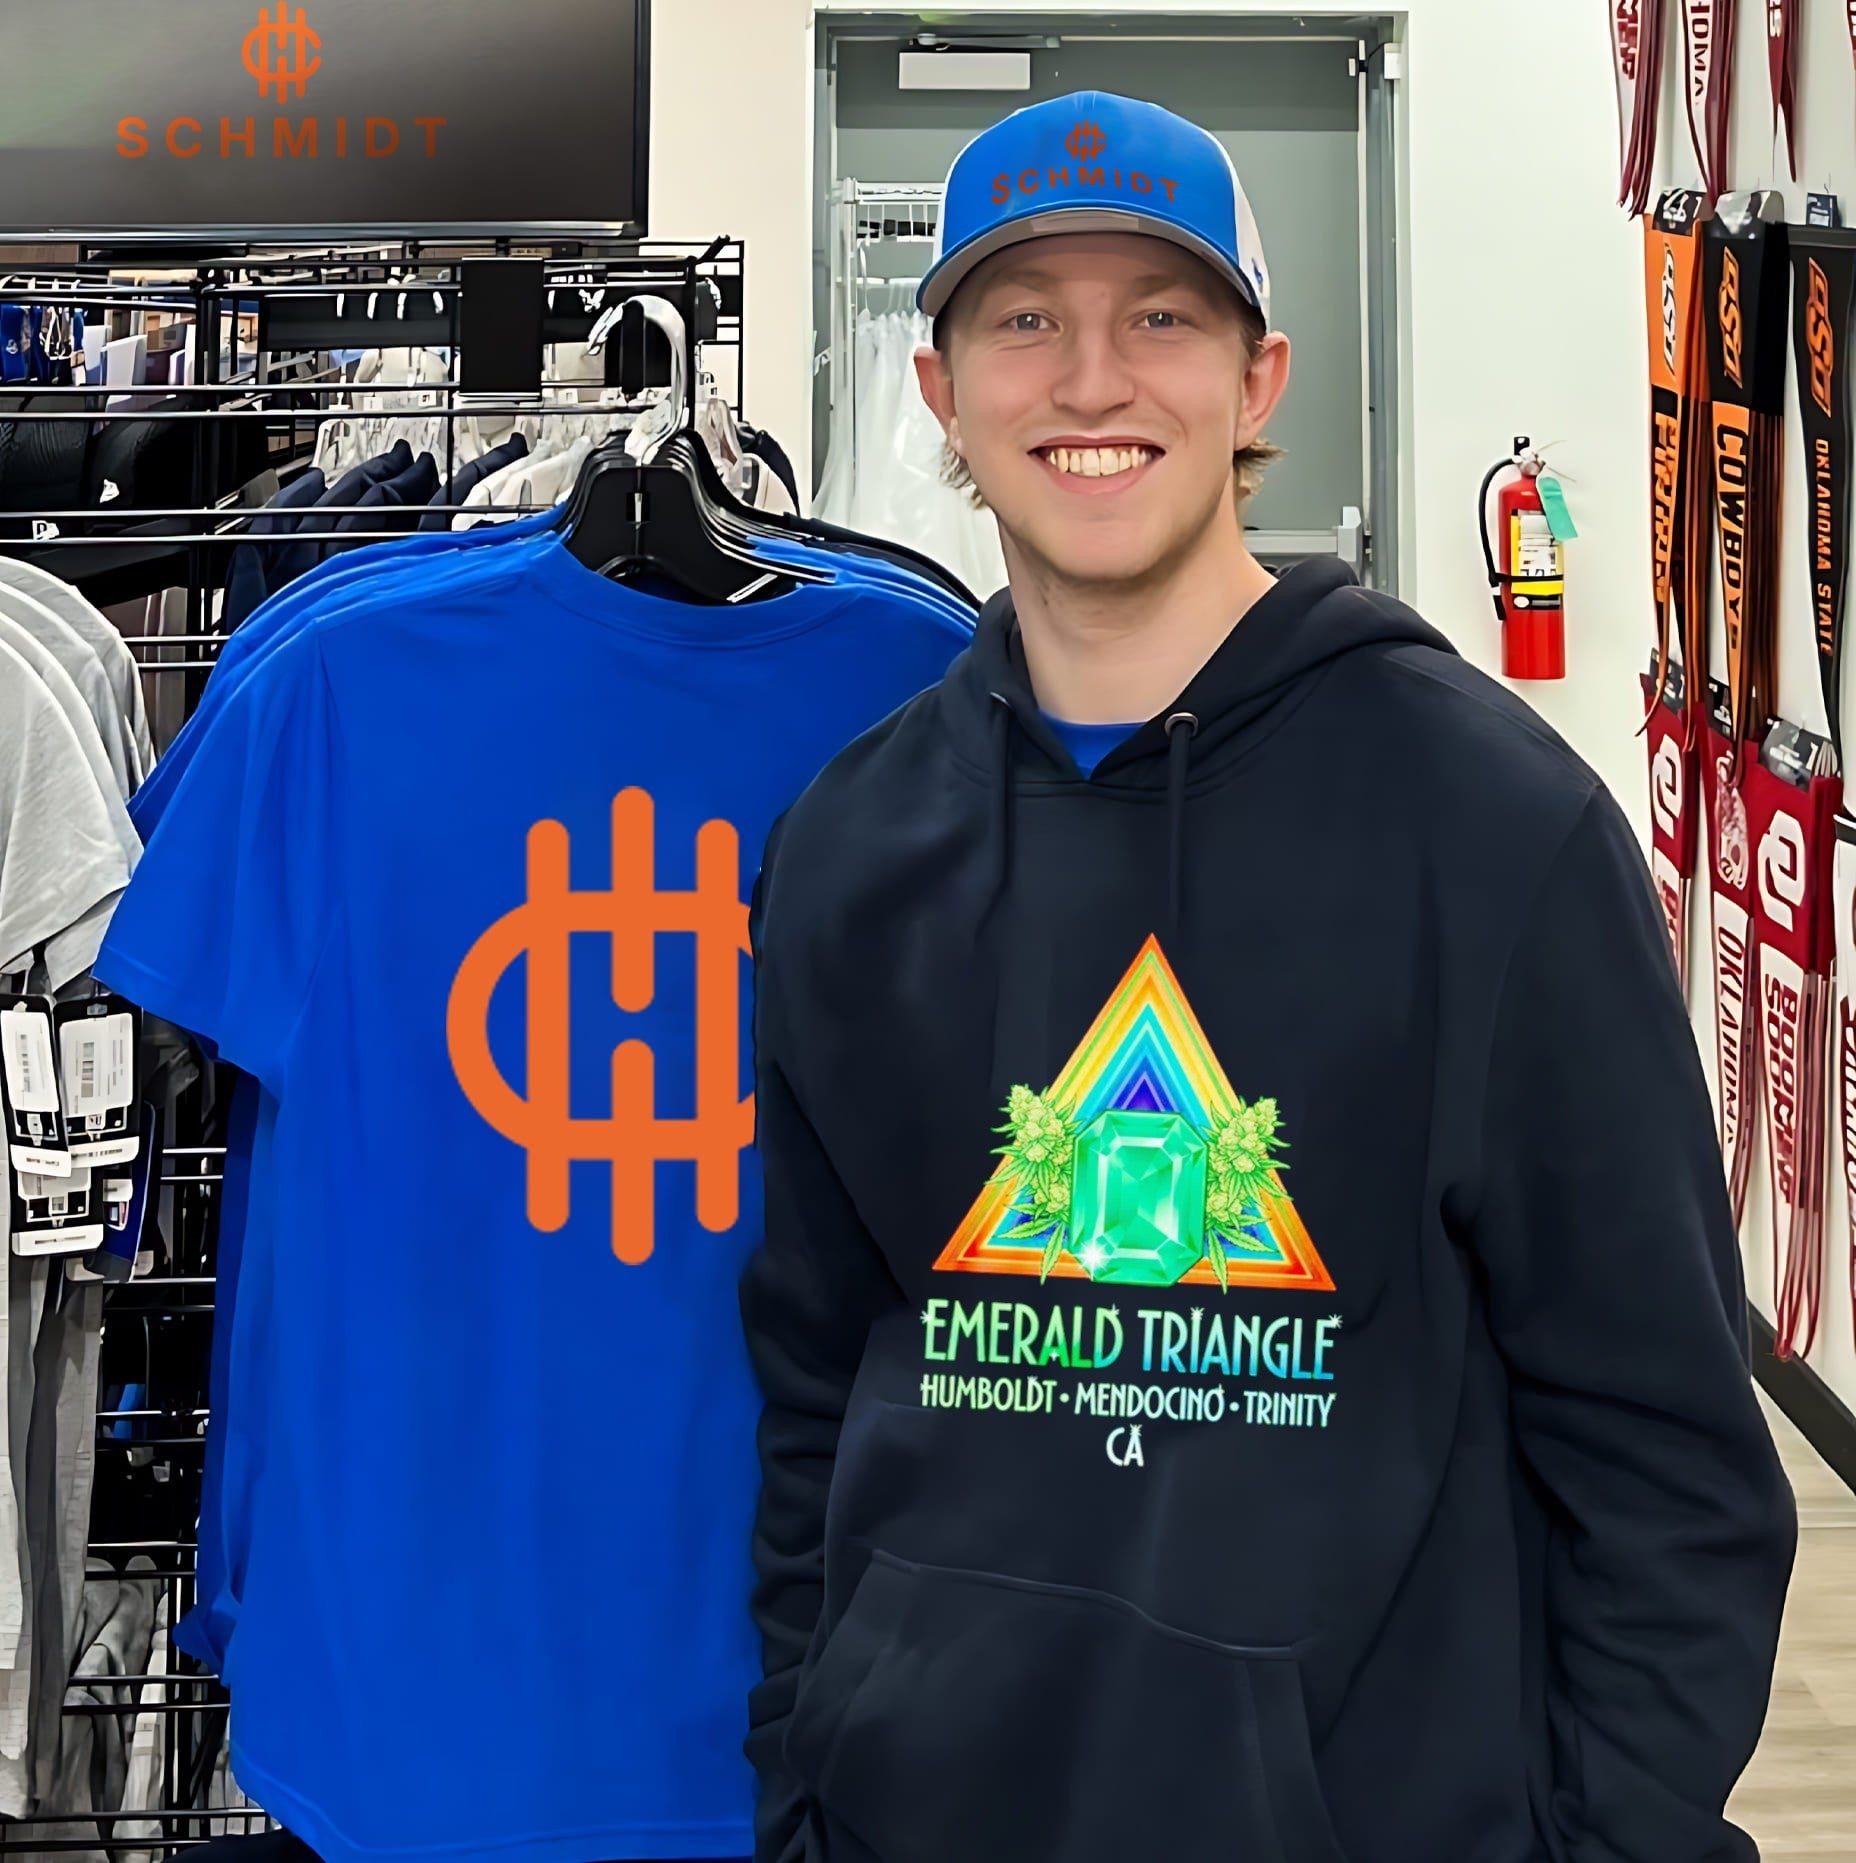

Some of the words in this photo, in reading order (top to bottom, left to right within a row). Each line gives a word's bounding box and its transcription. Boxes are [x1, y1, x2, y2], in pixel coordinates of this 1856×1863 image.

[116, 116, 448, 159] SCHMIDT
[991, 166, 1179, 204] SCHMIDT
[1815, 438, 1832, 570] OKLAHOMA
[922, 1298, 1124, 1369] EMERALD
[1138, 1307, 1341, 1380] TRIANGLE
[921, 1375, 1058, 1413] HUMBOLDT
[1075, 1383, 1224, 1422] MENDOCINO
[1244, 1391, 1335, 1427] TRINITY
[1106, 1425, 1144, 1466] CA
